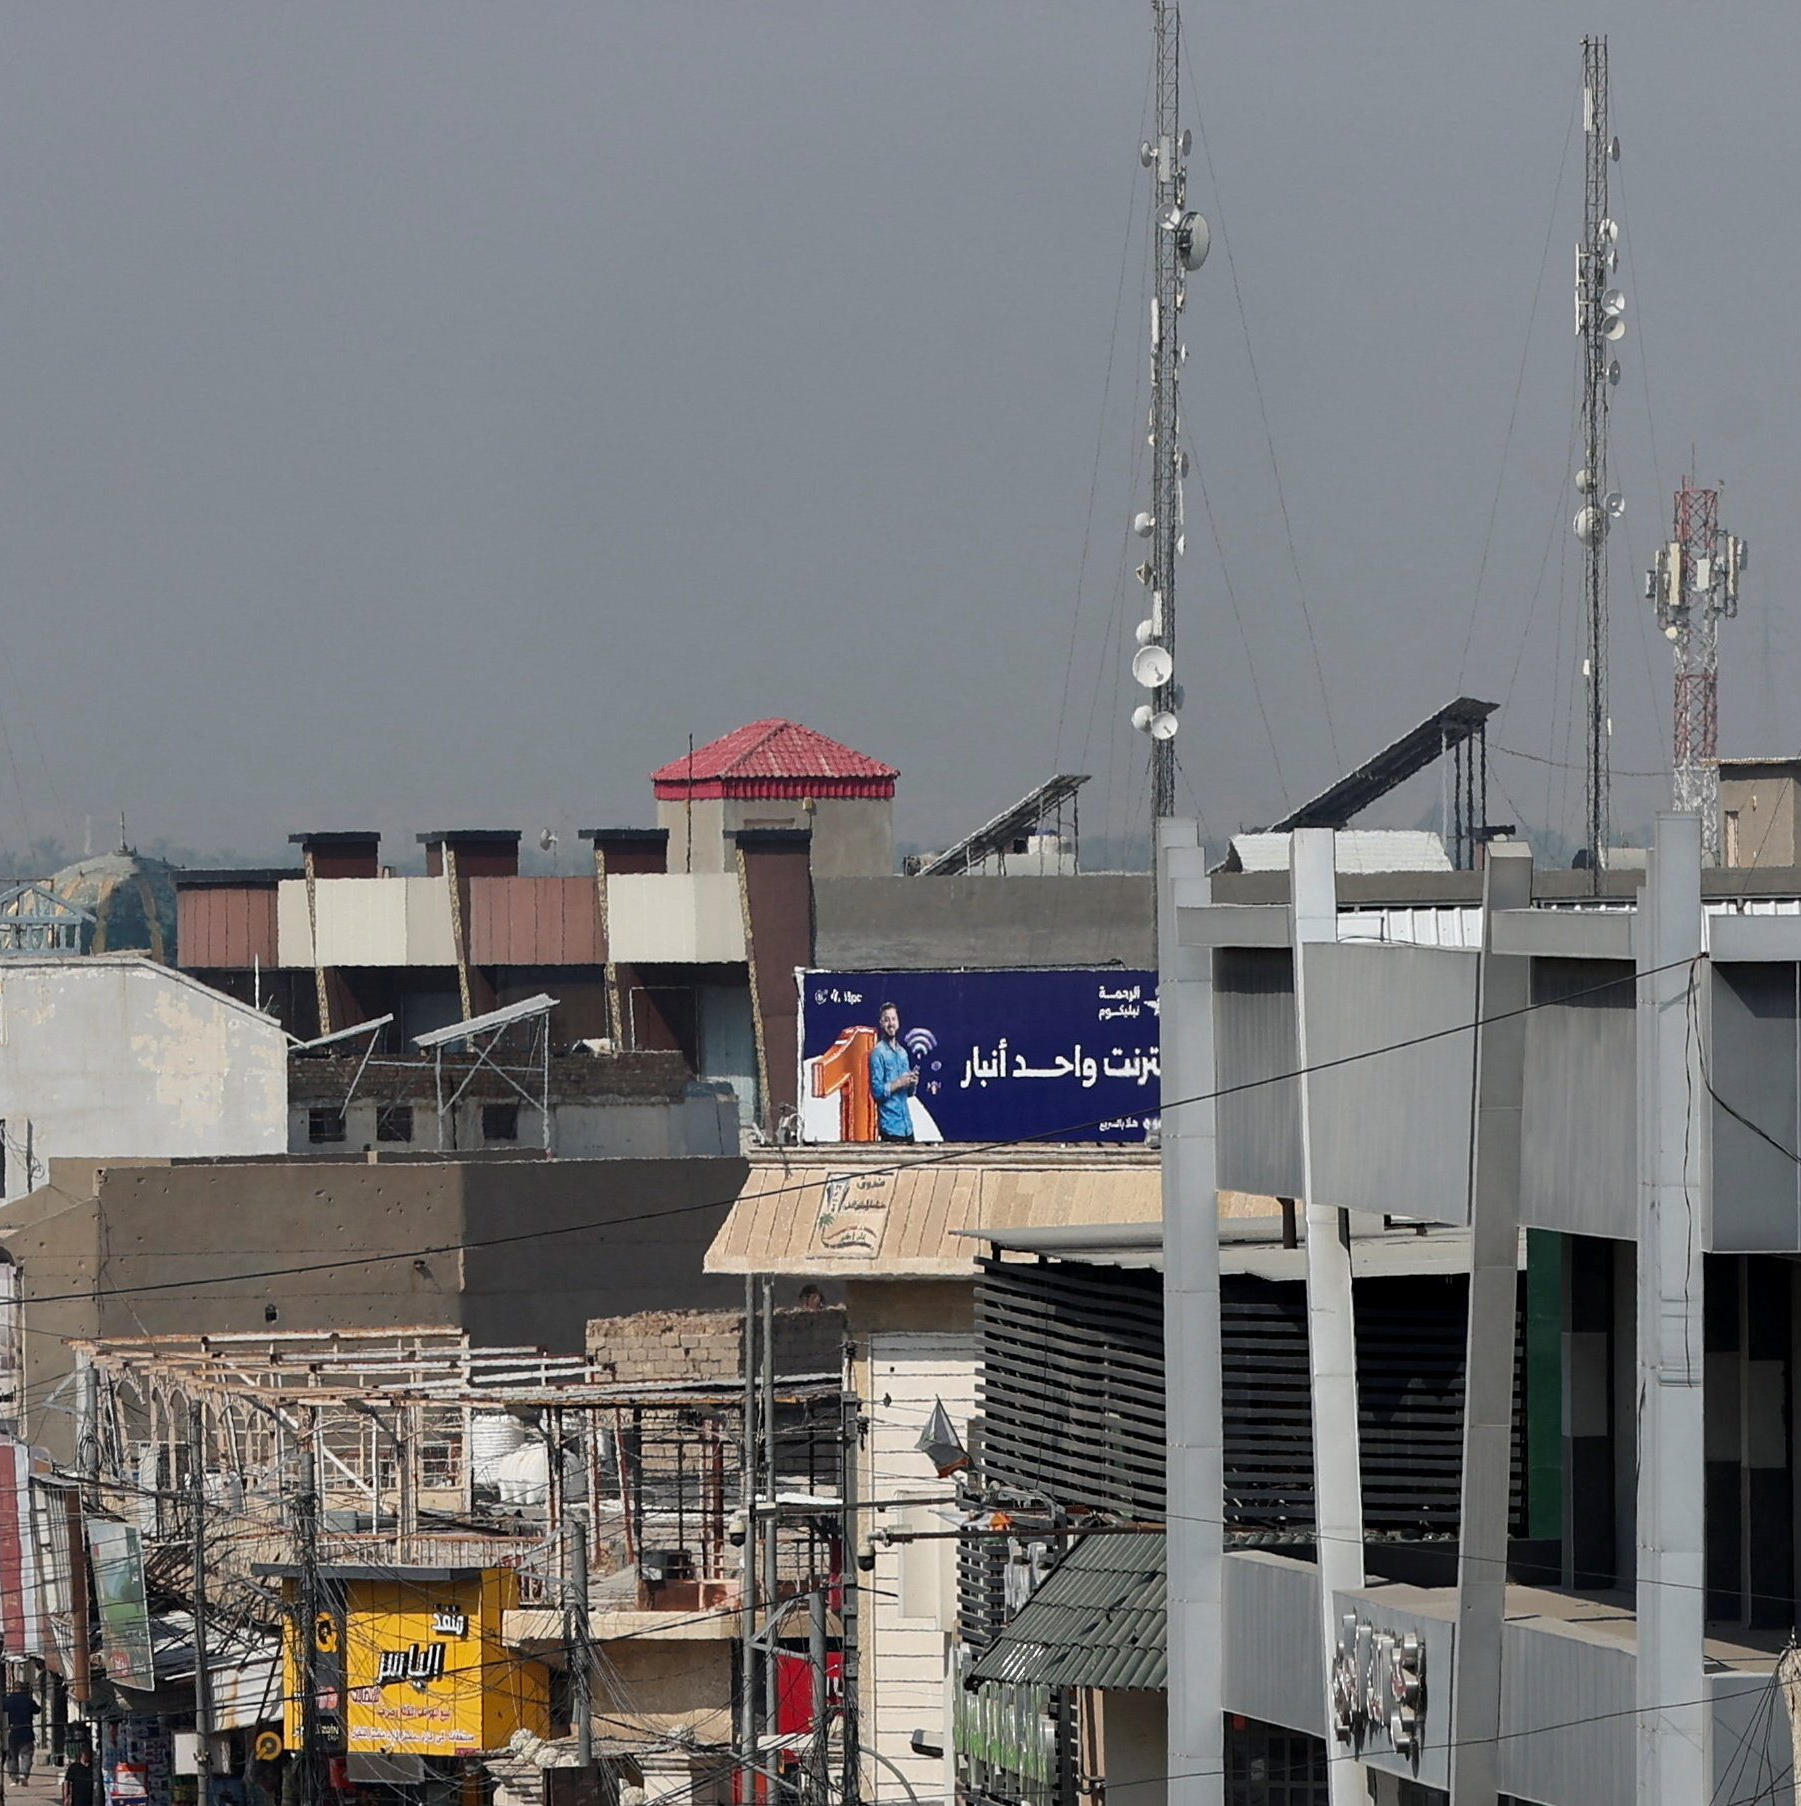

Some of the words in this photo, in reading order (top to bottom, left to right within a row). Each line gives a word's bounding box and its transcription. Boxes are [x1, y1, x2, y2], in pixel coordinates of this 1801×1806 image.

[1098, 984, 1141, 1002] الرحمة
[959, 1037, 1009, 1089] أنبار
[1012, 1043, 1098, 1088] واحد
[1103, 1046, 1161, 1086] ترنت
